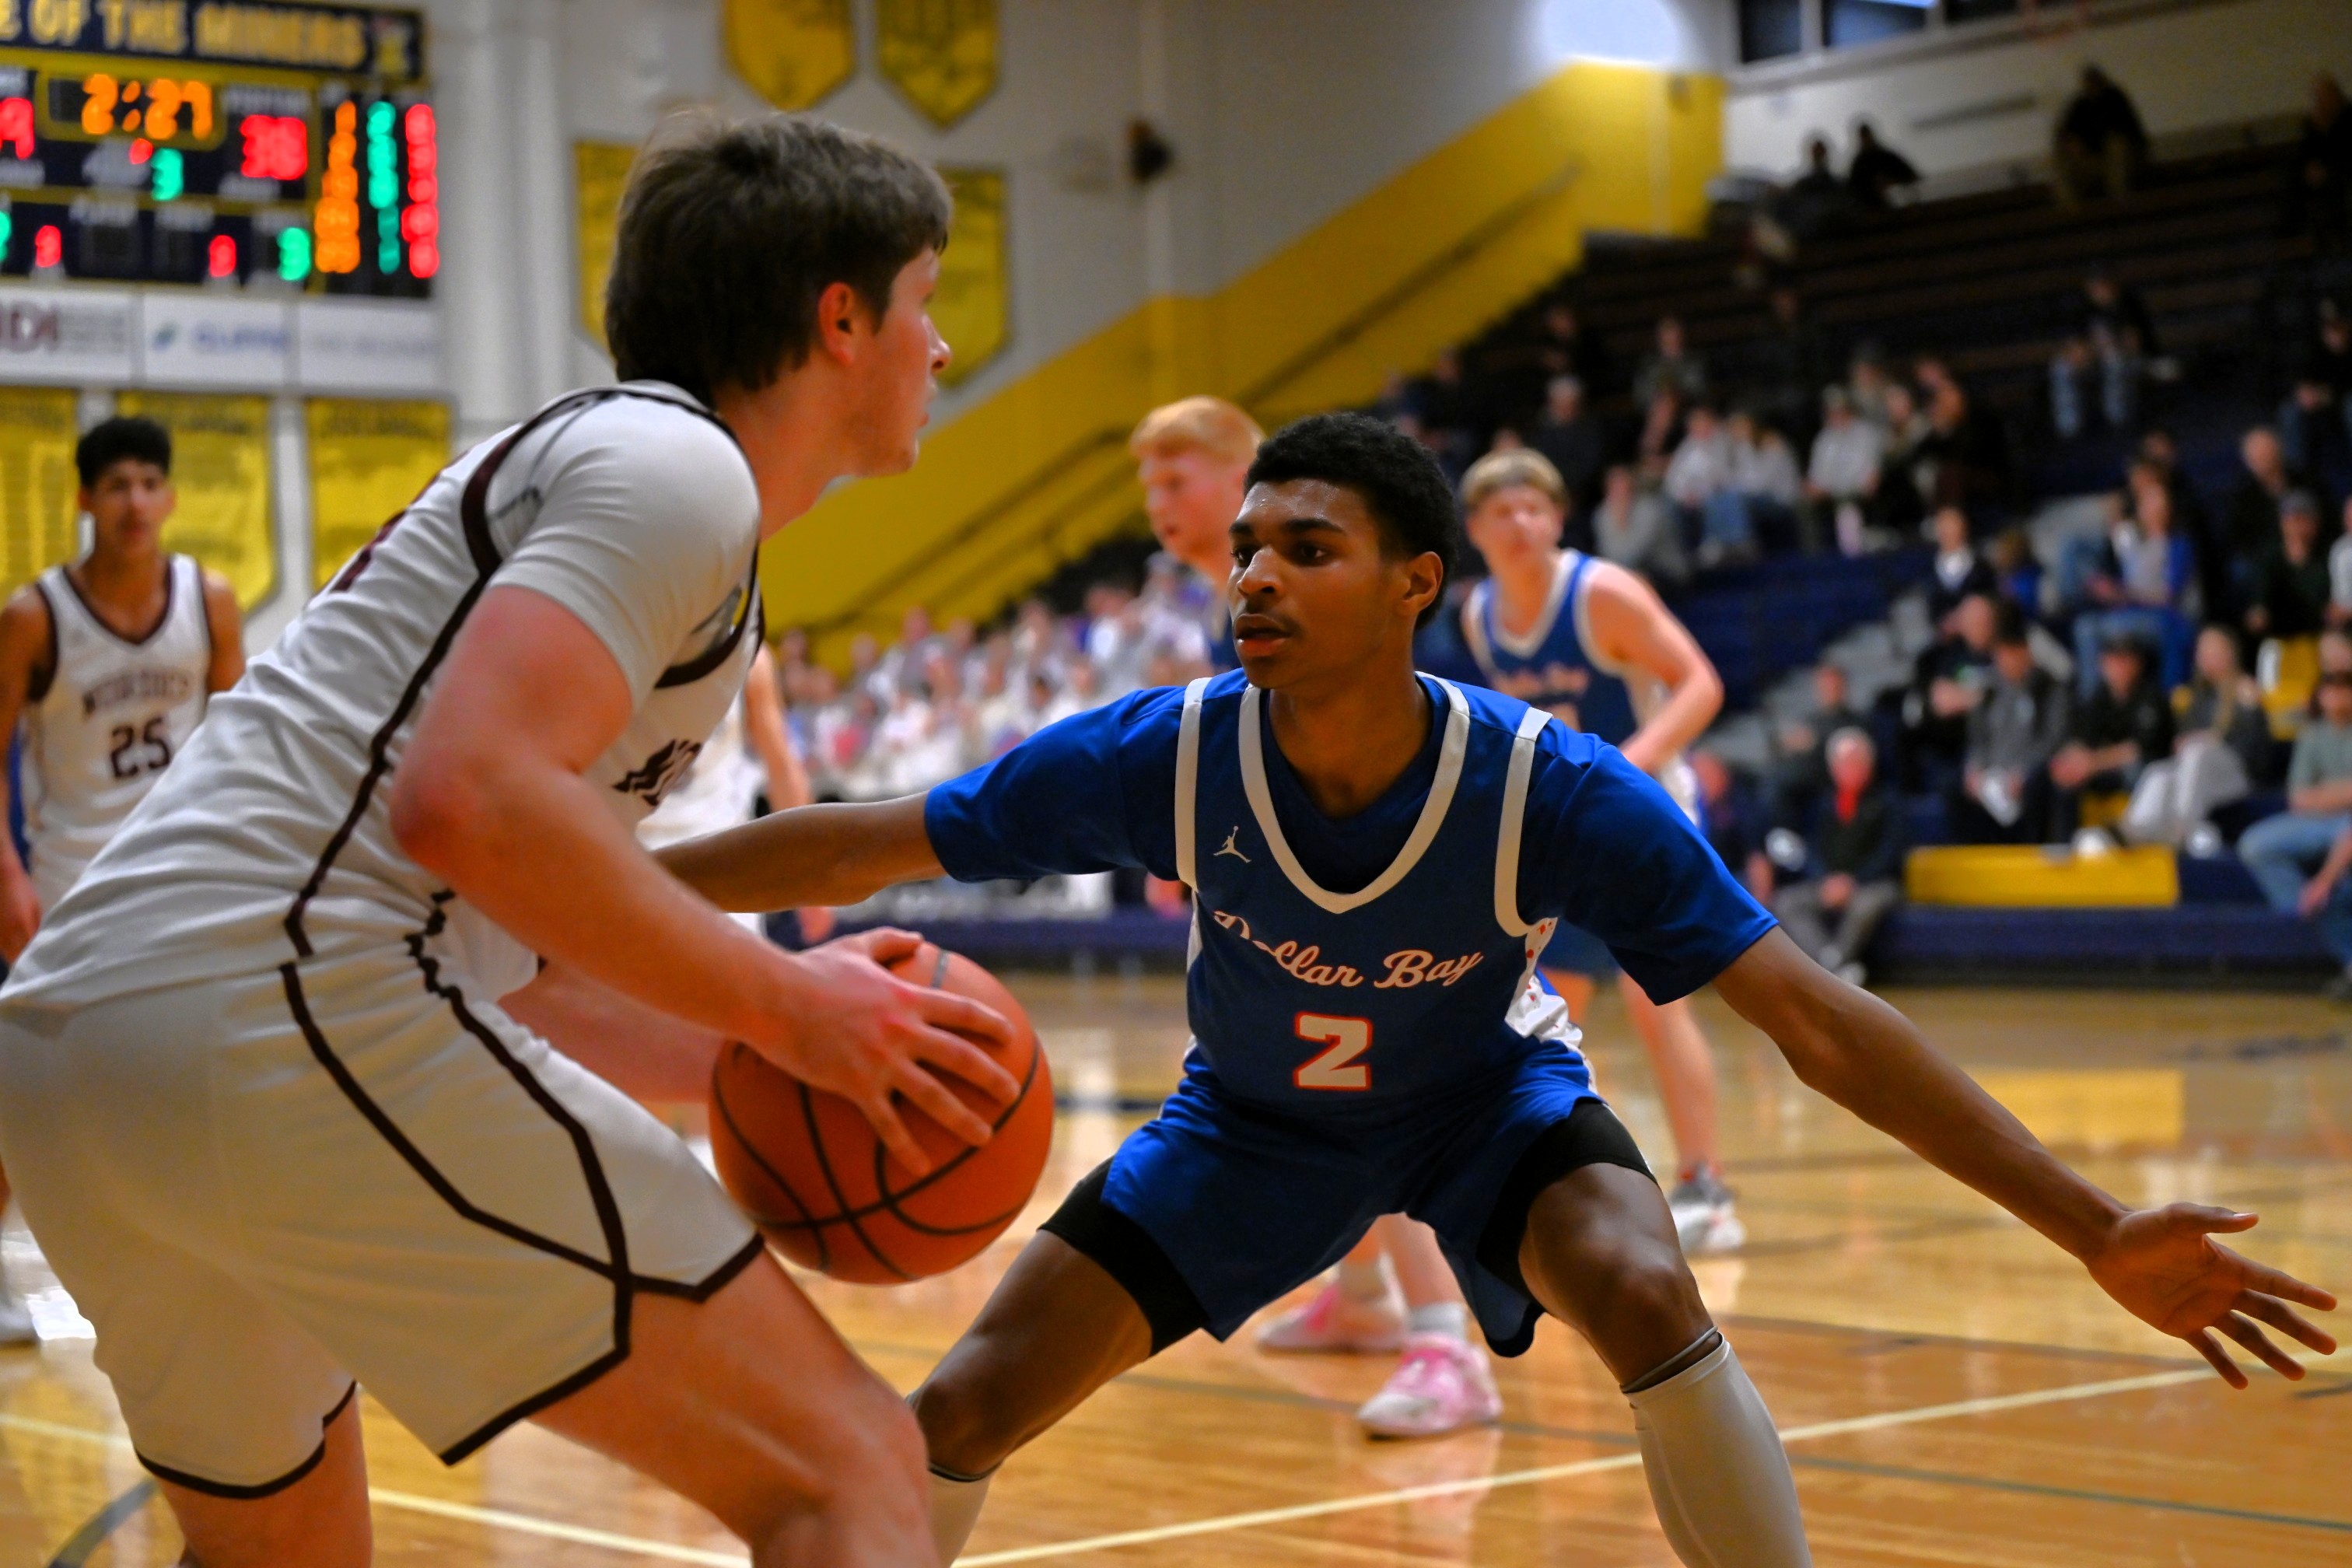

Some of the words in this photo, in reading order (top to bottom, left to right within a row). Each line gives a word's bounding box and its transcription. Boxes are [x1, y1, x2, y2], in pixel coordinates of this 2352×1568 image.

[30, 0, 90, 45] OF
[97, 2, 187, 54] THE
[81, 74, 212, 140] 2:27
[110, 716, 171, 779] 25
[1213, 909, 1364, 988] Dllar
[1374, 949, 1485, 989] Bay
[1293, 1011, 1373, 1090] 2
